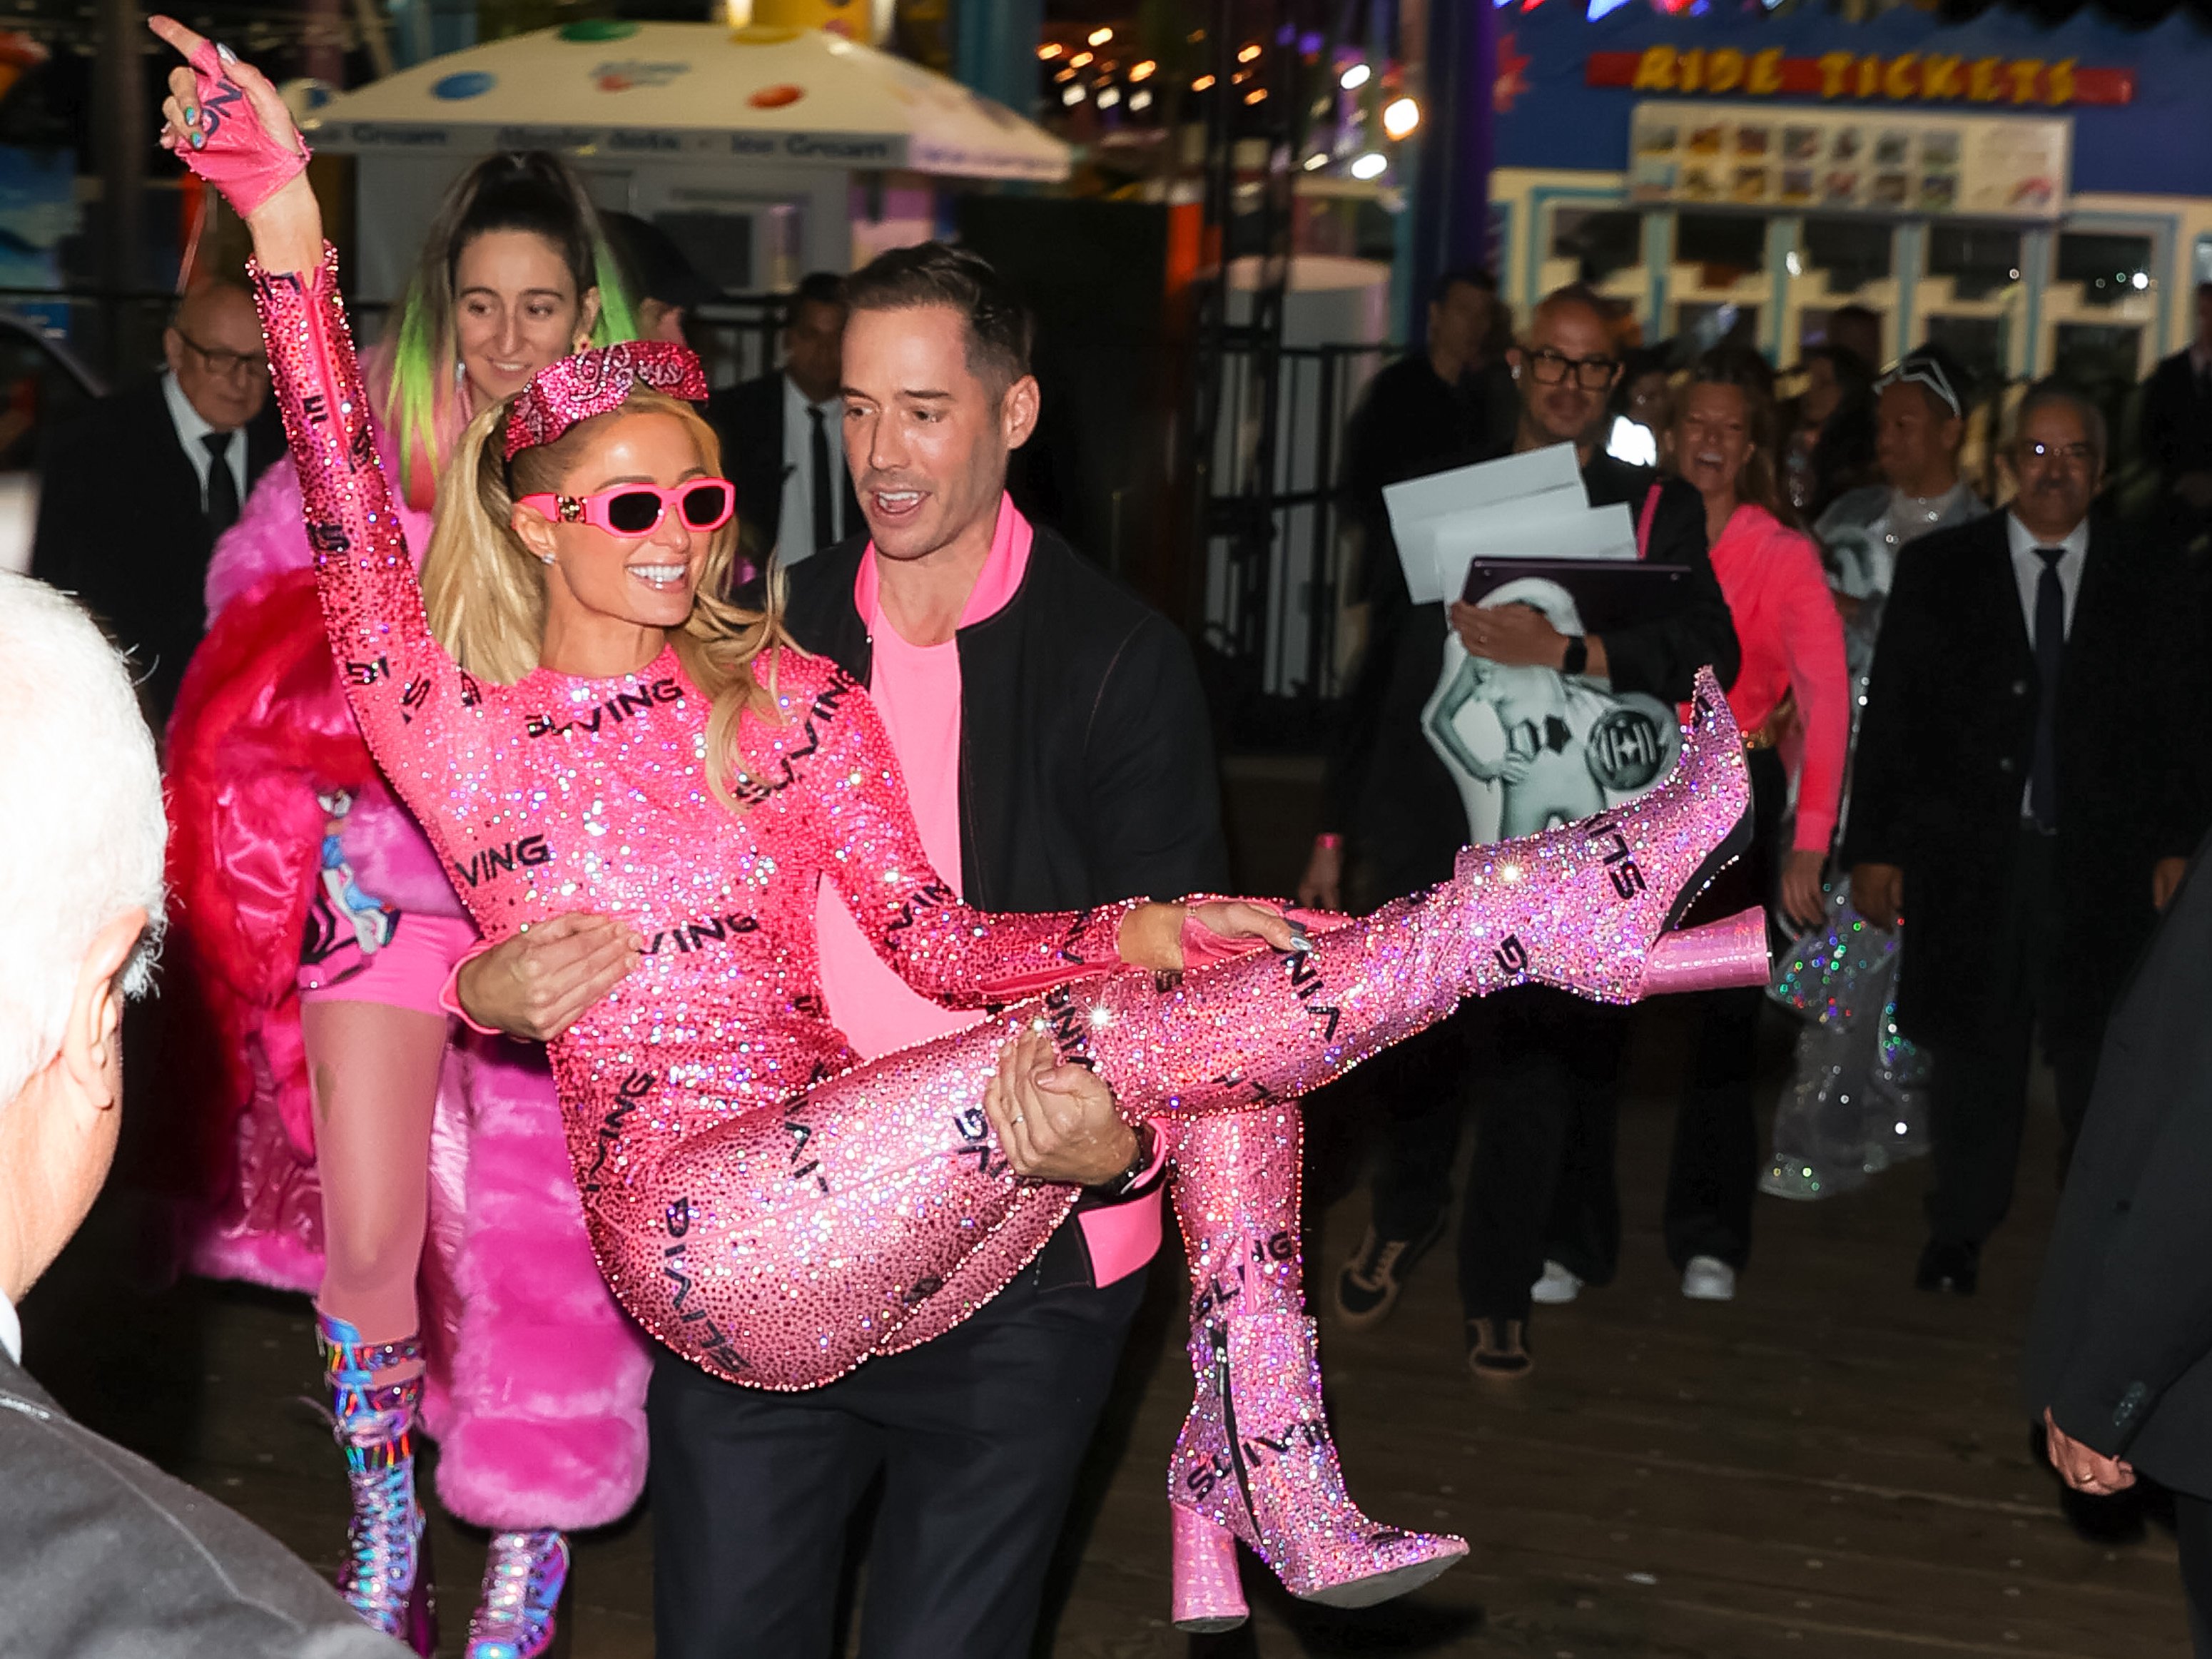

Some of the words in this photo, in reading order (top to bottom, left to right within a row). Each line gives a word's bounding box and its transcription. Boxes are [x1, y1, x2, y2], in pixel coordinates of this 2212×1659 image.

[1633, 44, 1784, 93] RIDE
[1819, 52, 2076, 106] TICKETS
[455, 833, 549, 888] VING
